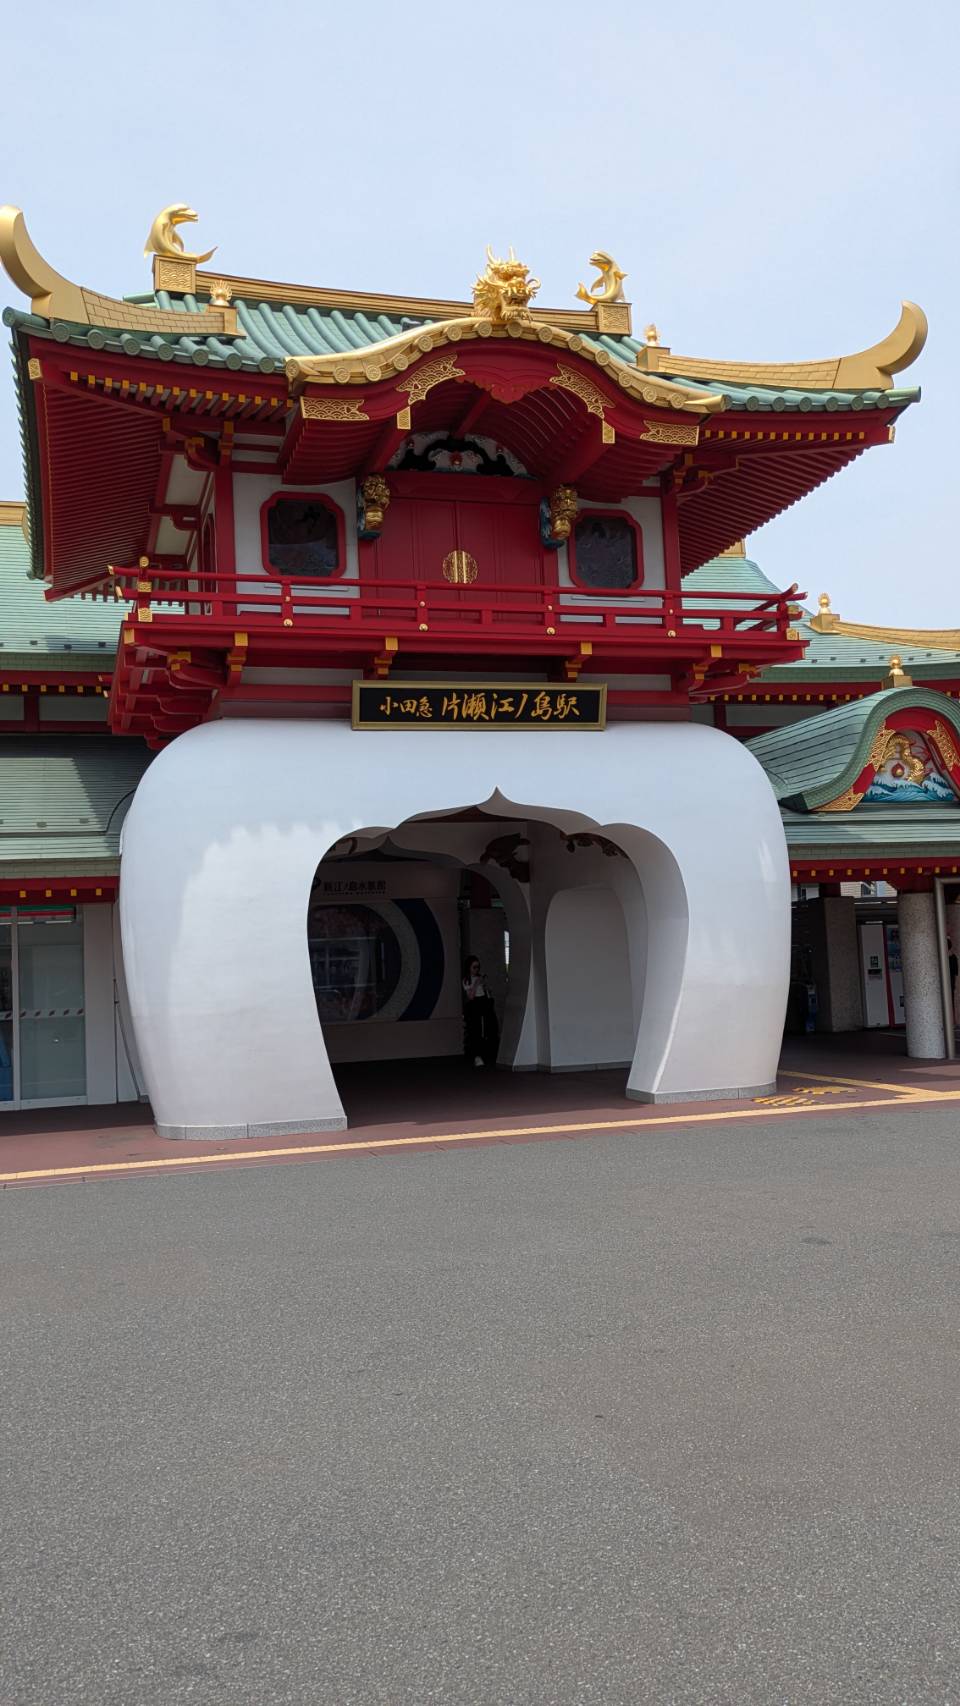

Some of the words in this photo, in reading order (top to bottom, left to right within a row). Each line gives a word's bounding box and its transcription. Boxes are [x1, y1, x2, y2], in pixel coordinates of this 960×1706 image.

[380, 696, 433, 718] 小田急
[441, 690, 581, 721] 片瀬江ノ島駅
